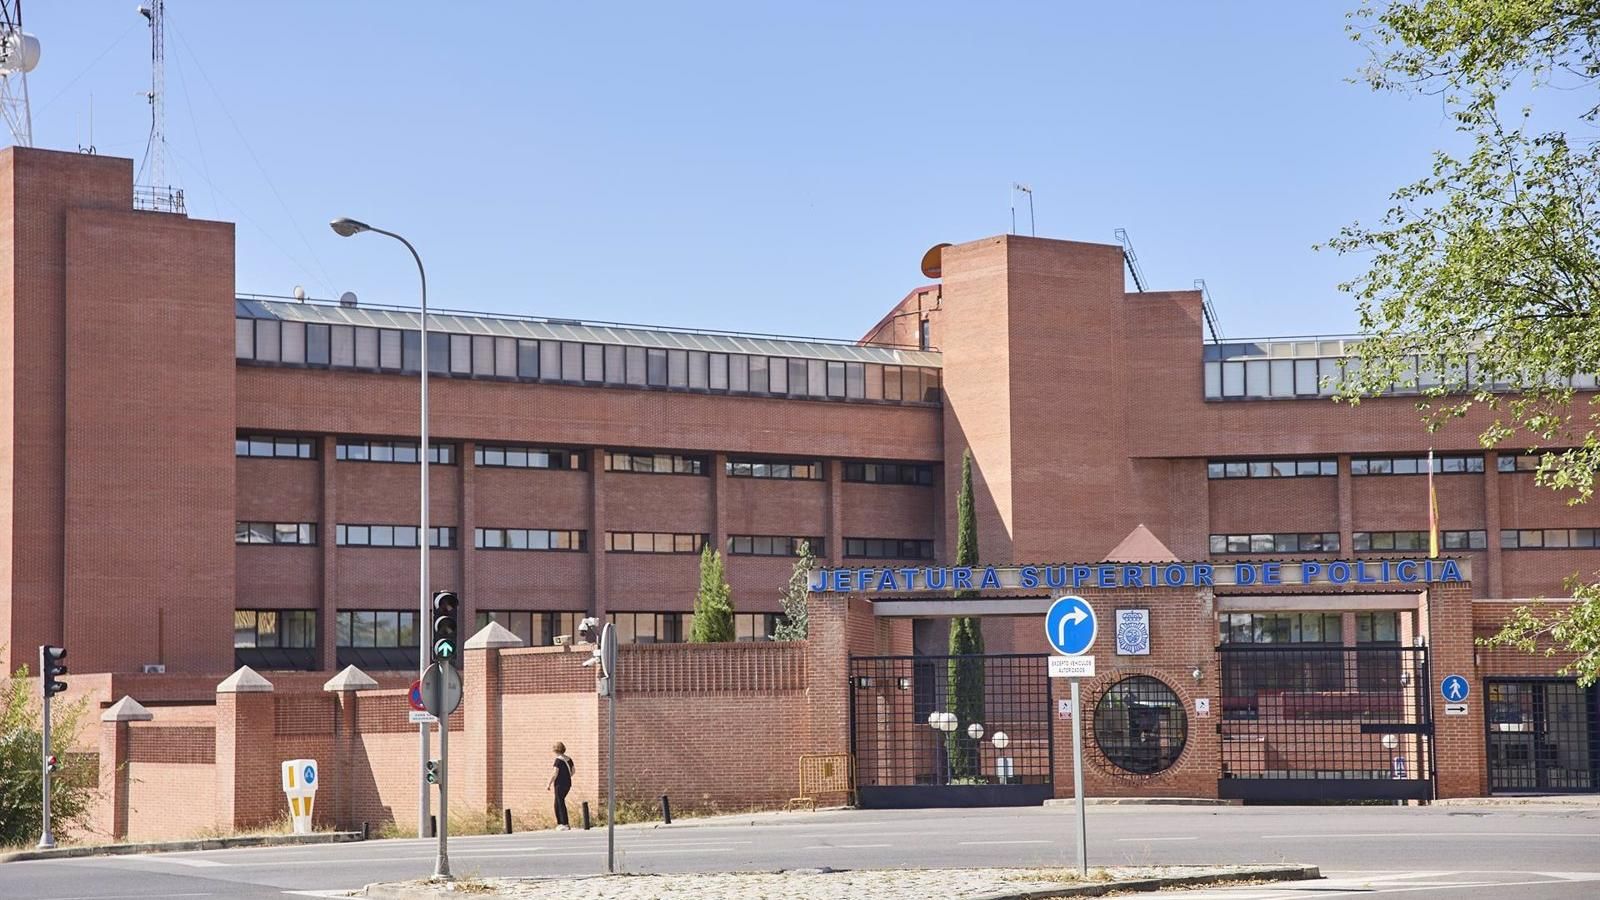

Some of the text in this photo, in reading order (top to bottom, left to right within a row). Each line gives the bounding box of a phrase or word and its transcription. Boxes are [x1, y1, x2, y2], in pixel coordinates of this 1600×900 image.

[810, 560, 1464, 593] JEFATURA SUPERIOR DE POLICIA
